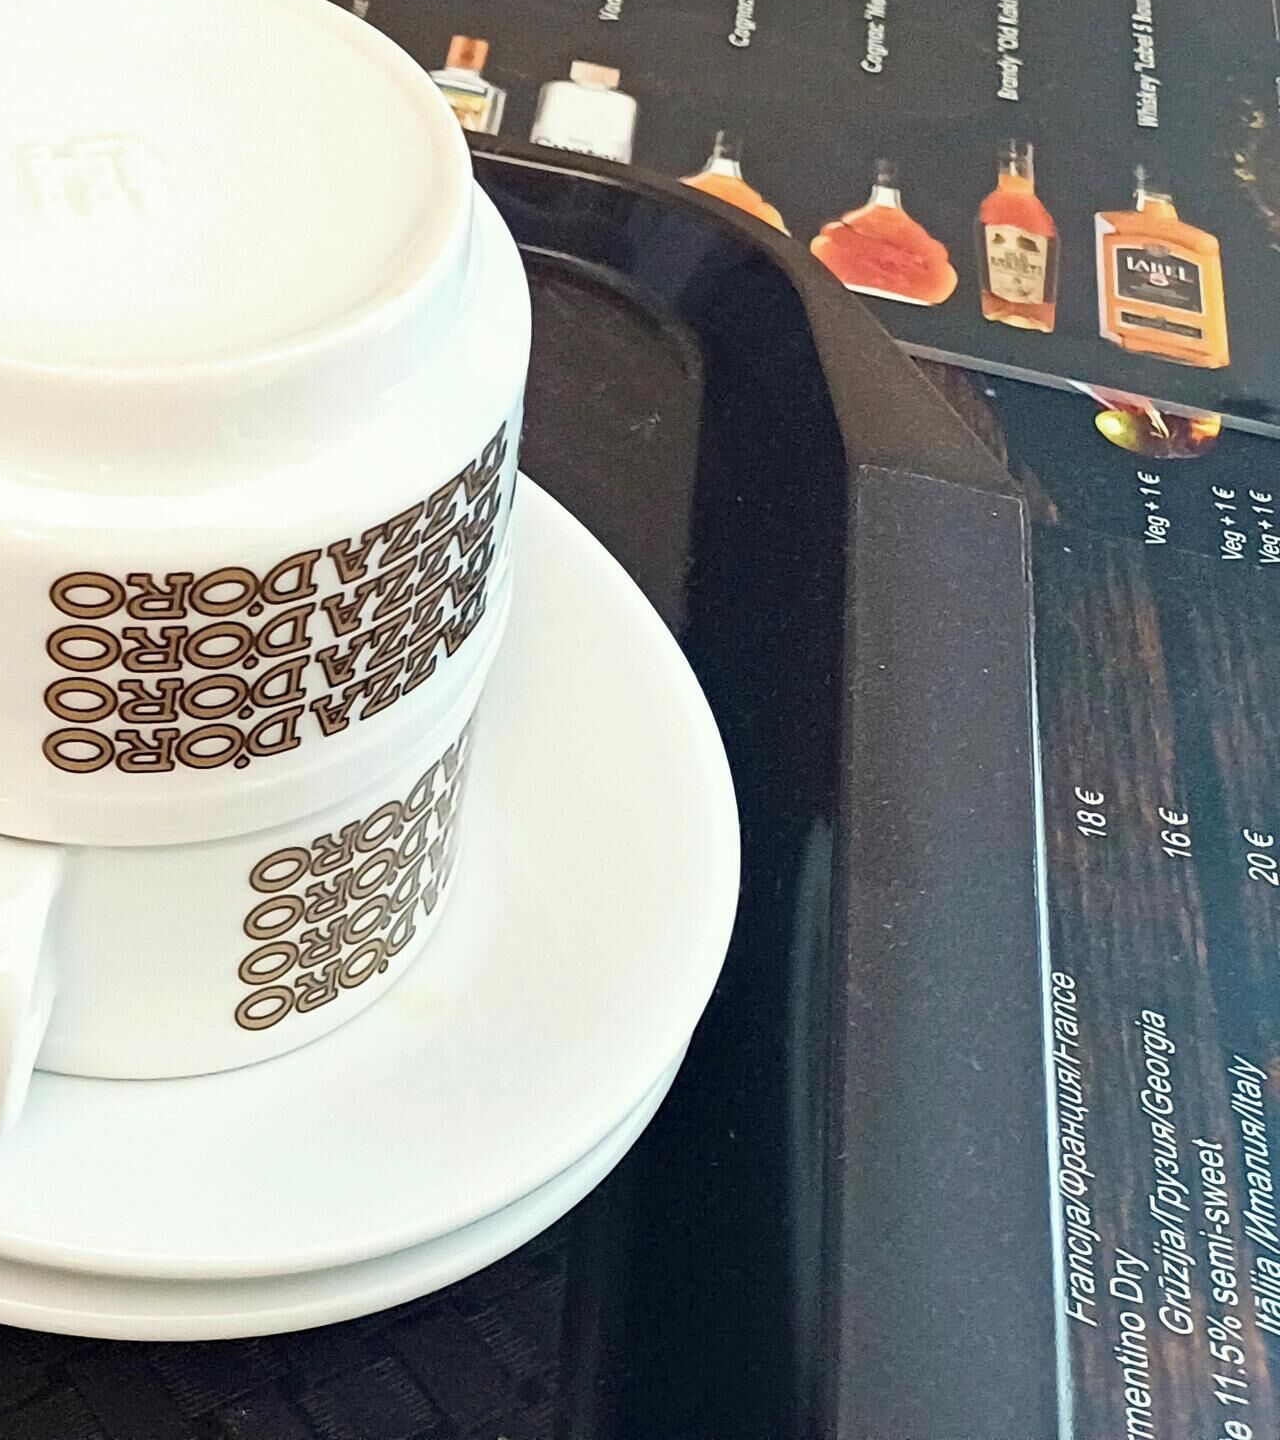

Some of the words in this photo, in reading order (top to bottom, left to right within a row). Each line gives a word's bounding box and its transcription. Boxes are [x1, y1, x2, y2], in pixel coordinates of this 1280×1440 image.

[861, 21, 888, 72] Cognac
[997, 55, 1023, 100] Brandy
[1136, 74, 1161, 127] Whiskey
[329, 420, 507, 584] TAZZA
[1144, 515, 1170, 544] Veg
[322, 475, 501, 638] TAZZA
[1220, 530, 1246, 560] Veg
[1258, 534, 1280, 563] Veg
[48, 550, 322, 620] D'ORO
[316, 527, 494, 688] TAZZA
[46, 603, 316, 672] D'ORO
[310, 577, 487, 737] TAZZA
[44, 656, 309, 723] D'ORO
[42, 704, 304, 774] D'ORO
[1076, 810, 1107, 836] 18
[1161, 830, 1192, 858] 16
[1246, 852, 1280, 886] 20
[1192, 1138, 1240, 1308] semi-sweet
[1110, 1249, 1150, 1305] Dry
[1207, 1315, 1250, 1406] 11.5%
